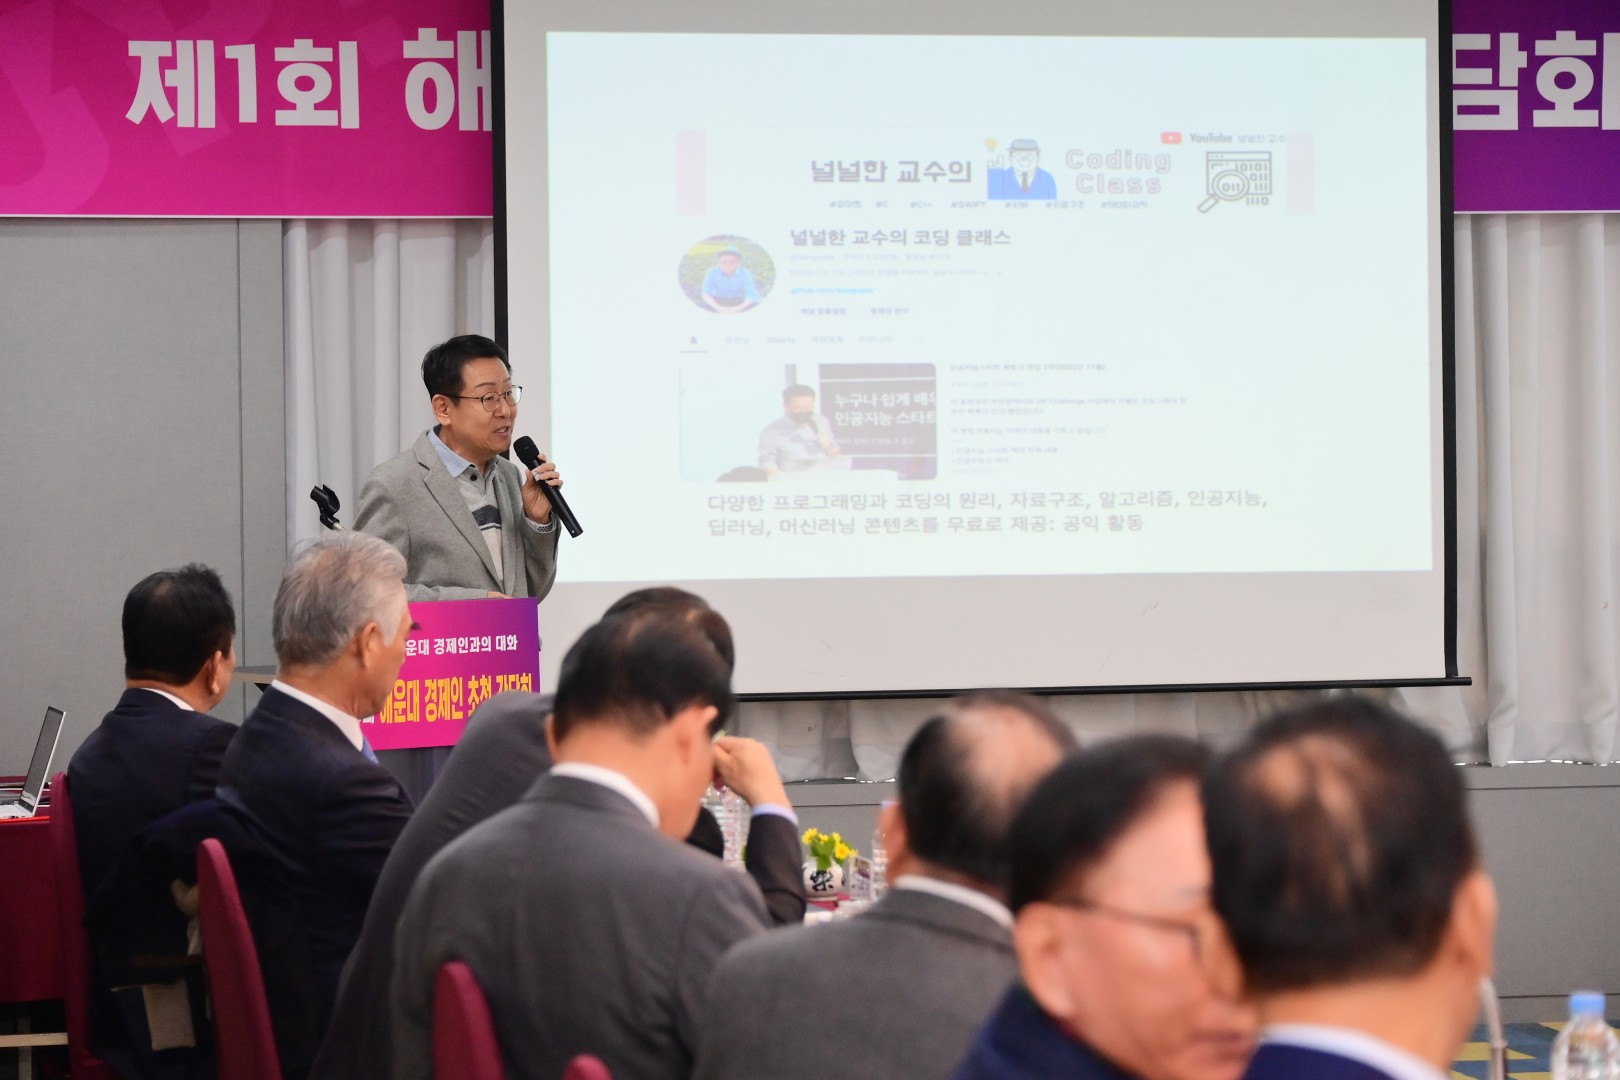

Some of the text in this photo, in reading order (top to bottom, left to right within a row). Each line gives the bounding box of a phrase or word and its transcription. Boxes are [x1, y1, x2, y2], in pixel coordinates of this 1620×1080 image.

[125, 38, 360, 129] 제1회
[1190, 133, 1233, 143] YouTube
[811, 160, 972, 183] 널널한 교수의
[1065, 149, 1172, 174] Coding
[1075, 173, 1162, 194] Class
[790, 229, 1012, 247] 널널한 교수의 코딩 클래스
[834, 392, 878, 408] 누구나
[881, 391, 911, 408] 쉽게
[834, 411, 893, 427] 인공지능
[707, 489, 1268, 512] 다양한 프로그래밍과 코딩의 원리, 자료구조, 알고리즘, 인공지능,
[708, 513, 1144, 537] 딥러닝, 머신러닝 콘텐츠를 무료로 제공: 공익 활동
[433, 635, 492, 655] 경제인과의
[495, 634, 518, 651] 대화
[424, 675, 464, 723] 경제인
